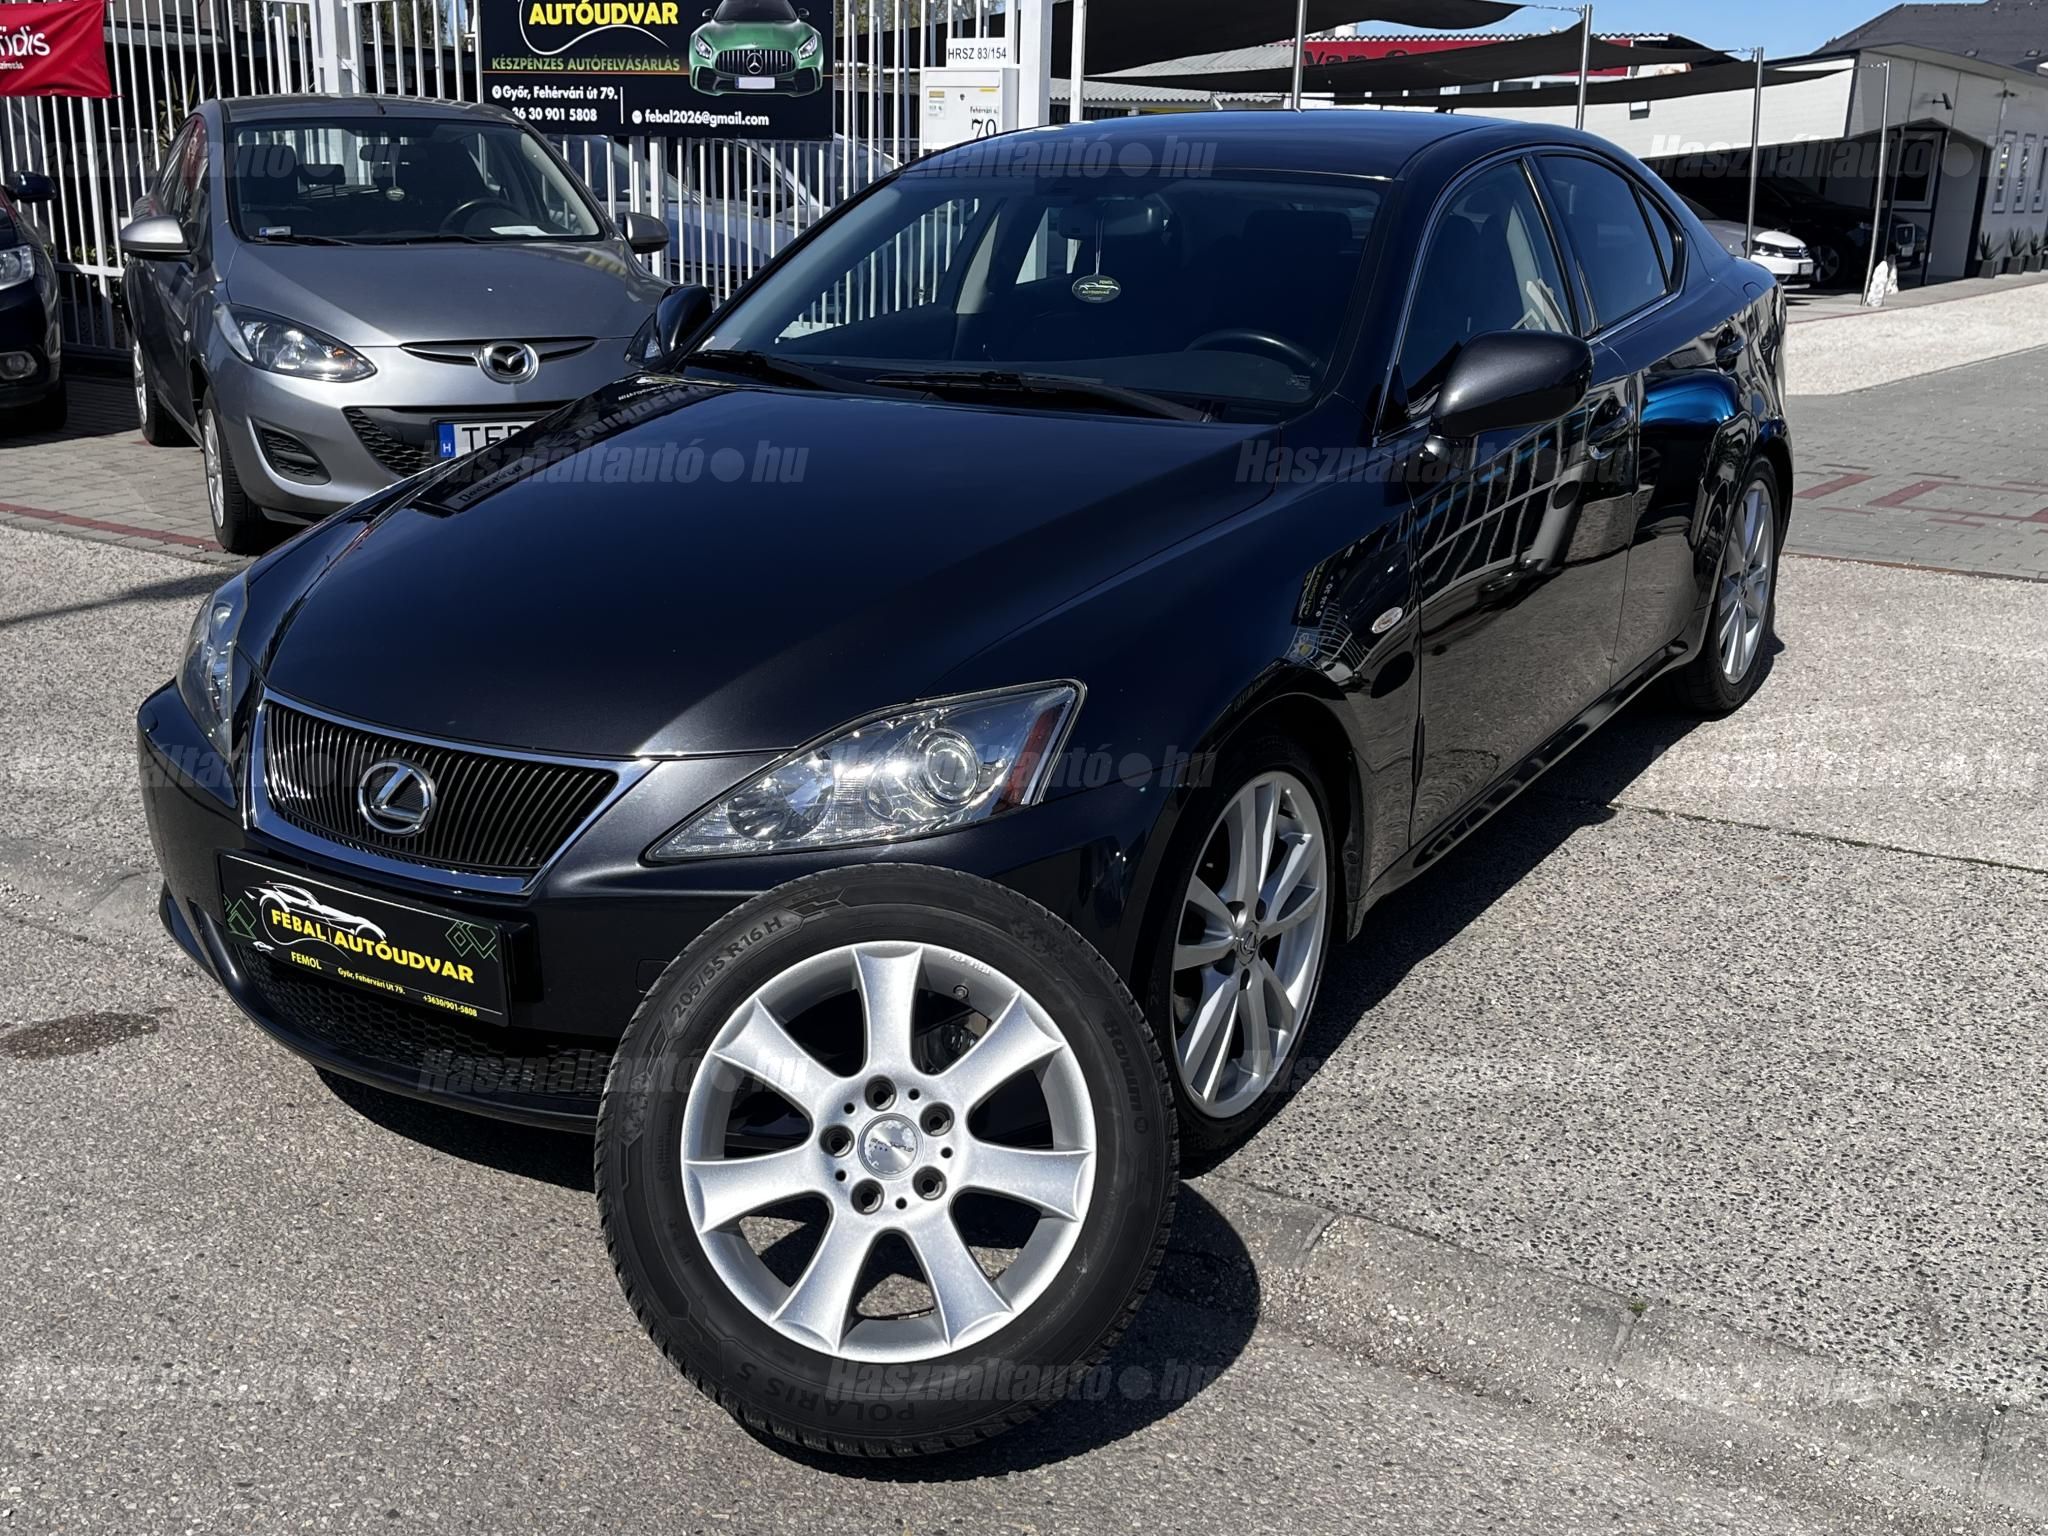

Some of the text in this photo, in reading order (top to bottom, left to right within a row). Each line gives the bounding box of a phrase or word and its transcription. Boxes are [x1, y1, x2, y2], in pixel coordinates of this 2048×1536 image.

[528, 0, 680, 25] AUTÓUDVAR
[491, 55, 681, 72] KÉSZPÉNZES AUTÓFELVÁSÁRLÁS
[947, 47, 1007, 60] HRSZ 83/154
[502, 84, 618, 101] Győr, Fehérvári út 79.
[528, 107, 543, 121] 30
[544, 107, 566, 121] 901
[569, 107, 598, 122] 5808
[644, 108, 770, 127] febal2026@gmail.com
[270, 907, 475, 984] FEBAL AUTÓUDVAR
[290, 951, 323, 971] FEMOL
[671, 916, 783, 1019] 205/55 R16 H
[422, 994, 478, 1017] +3630/901-5808
[764, 1377, 916, 1422] POLARIS
